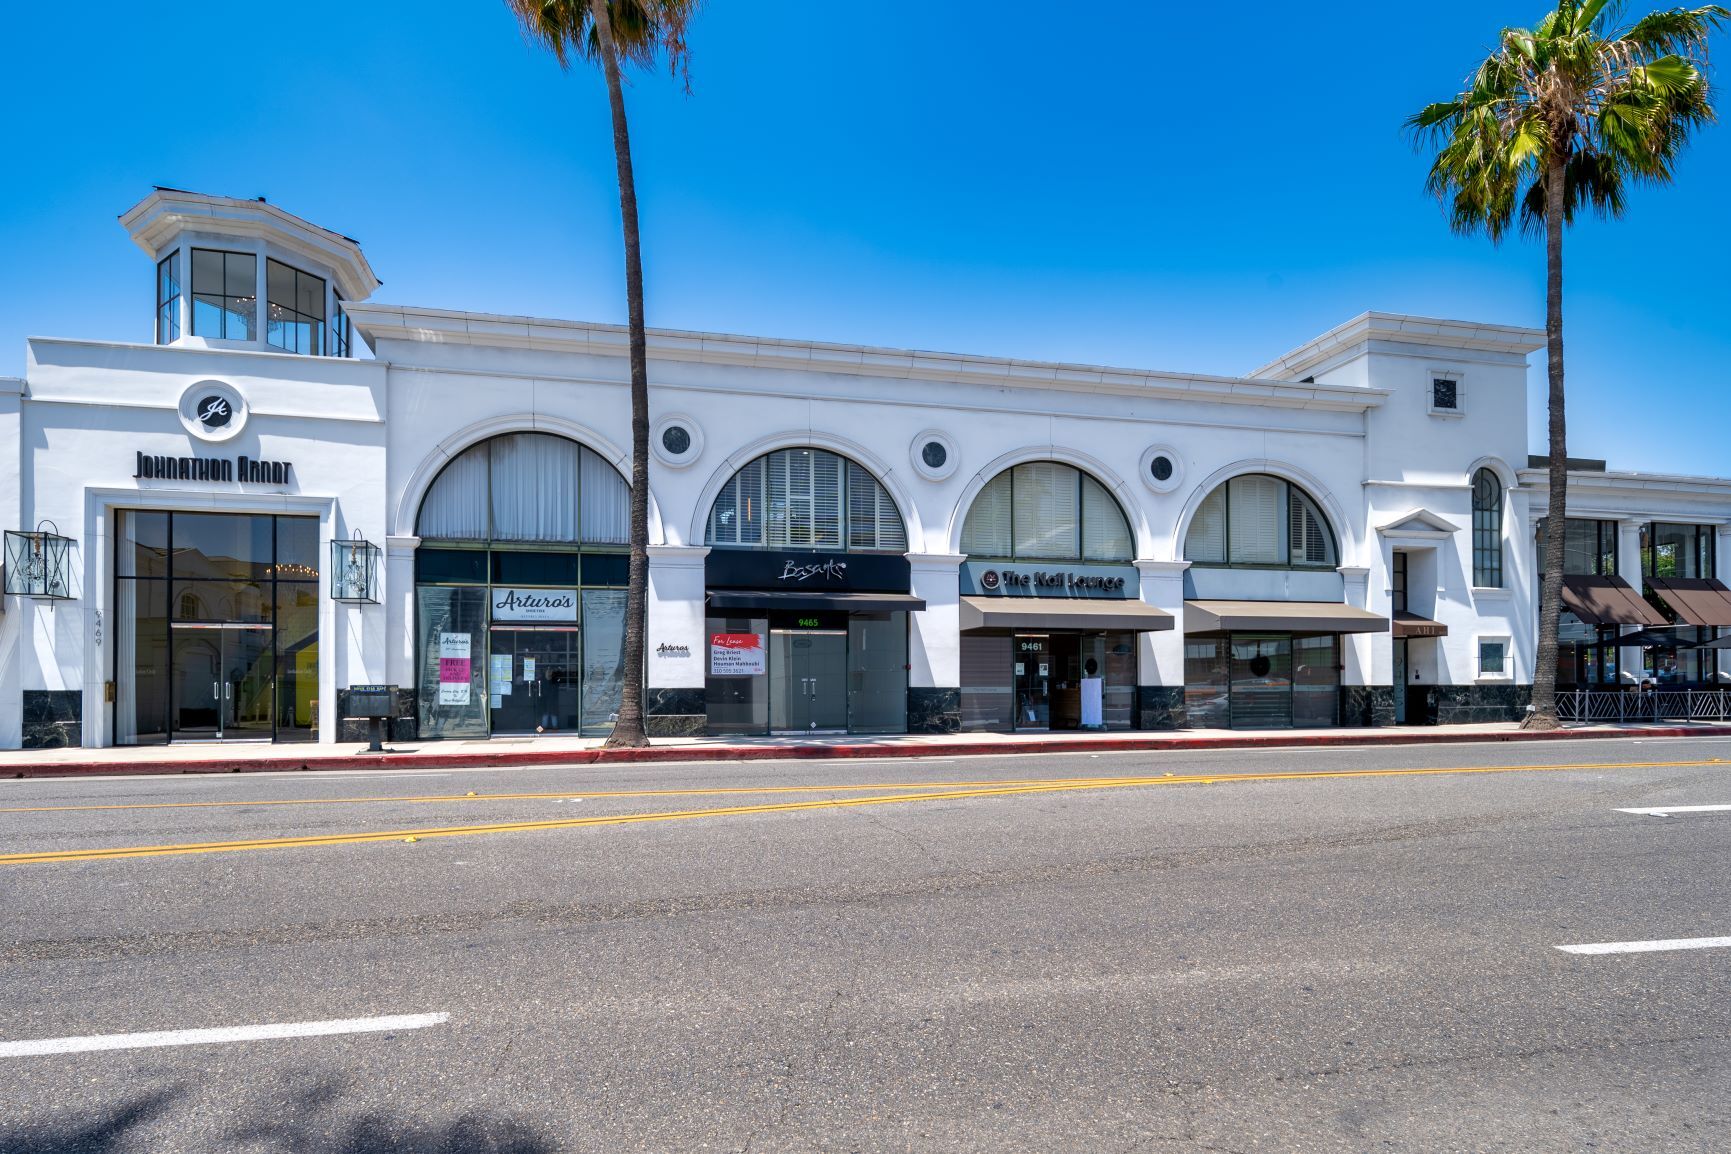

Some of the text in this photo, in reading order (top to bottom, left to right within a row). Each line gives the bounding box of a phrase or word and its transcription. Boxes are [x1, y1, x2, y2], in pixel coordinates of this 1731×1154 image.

[1002, 571, 1030, 586] The
[1033, 571, 1065, 588] Nail
[1067, 572, 1126, 593] Lounge
[496, 590, 574, 611] Arturo's
[798, 618, 819, 627] 9465
[713, 635, 743, 645] For Lease
[1021, 642, 1042, 651] 9461
